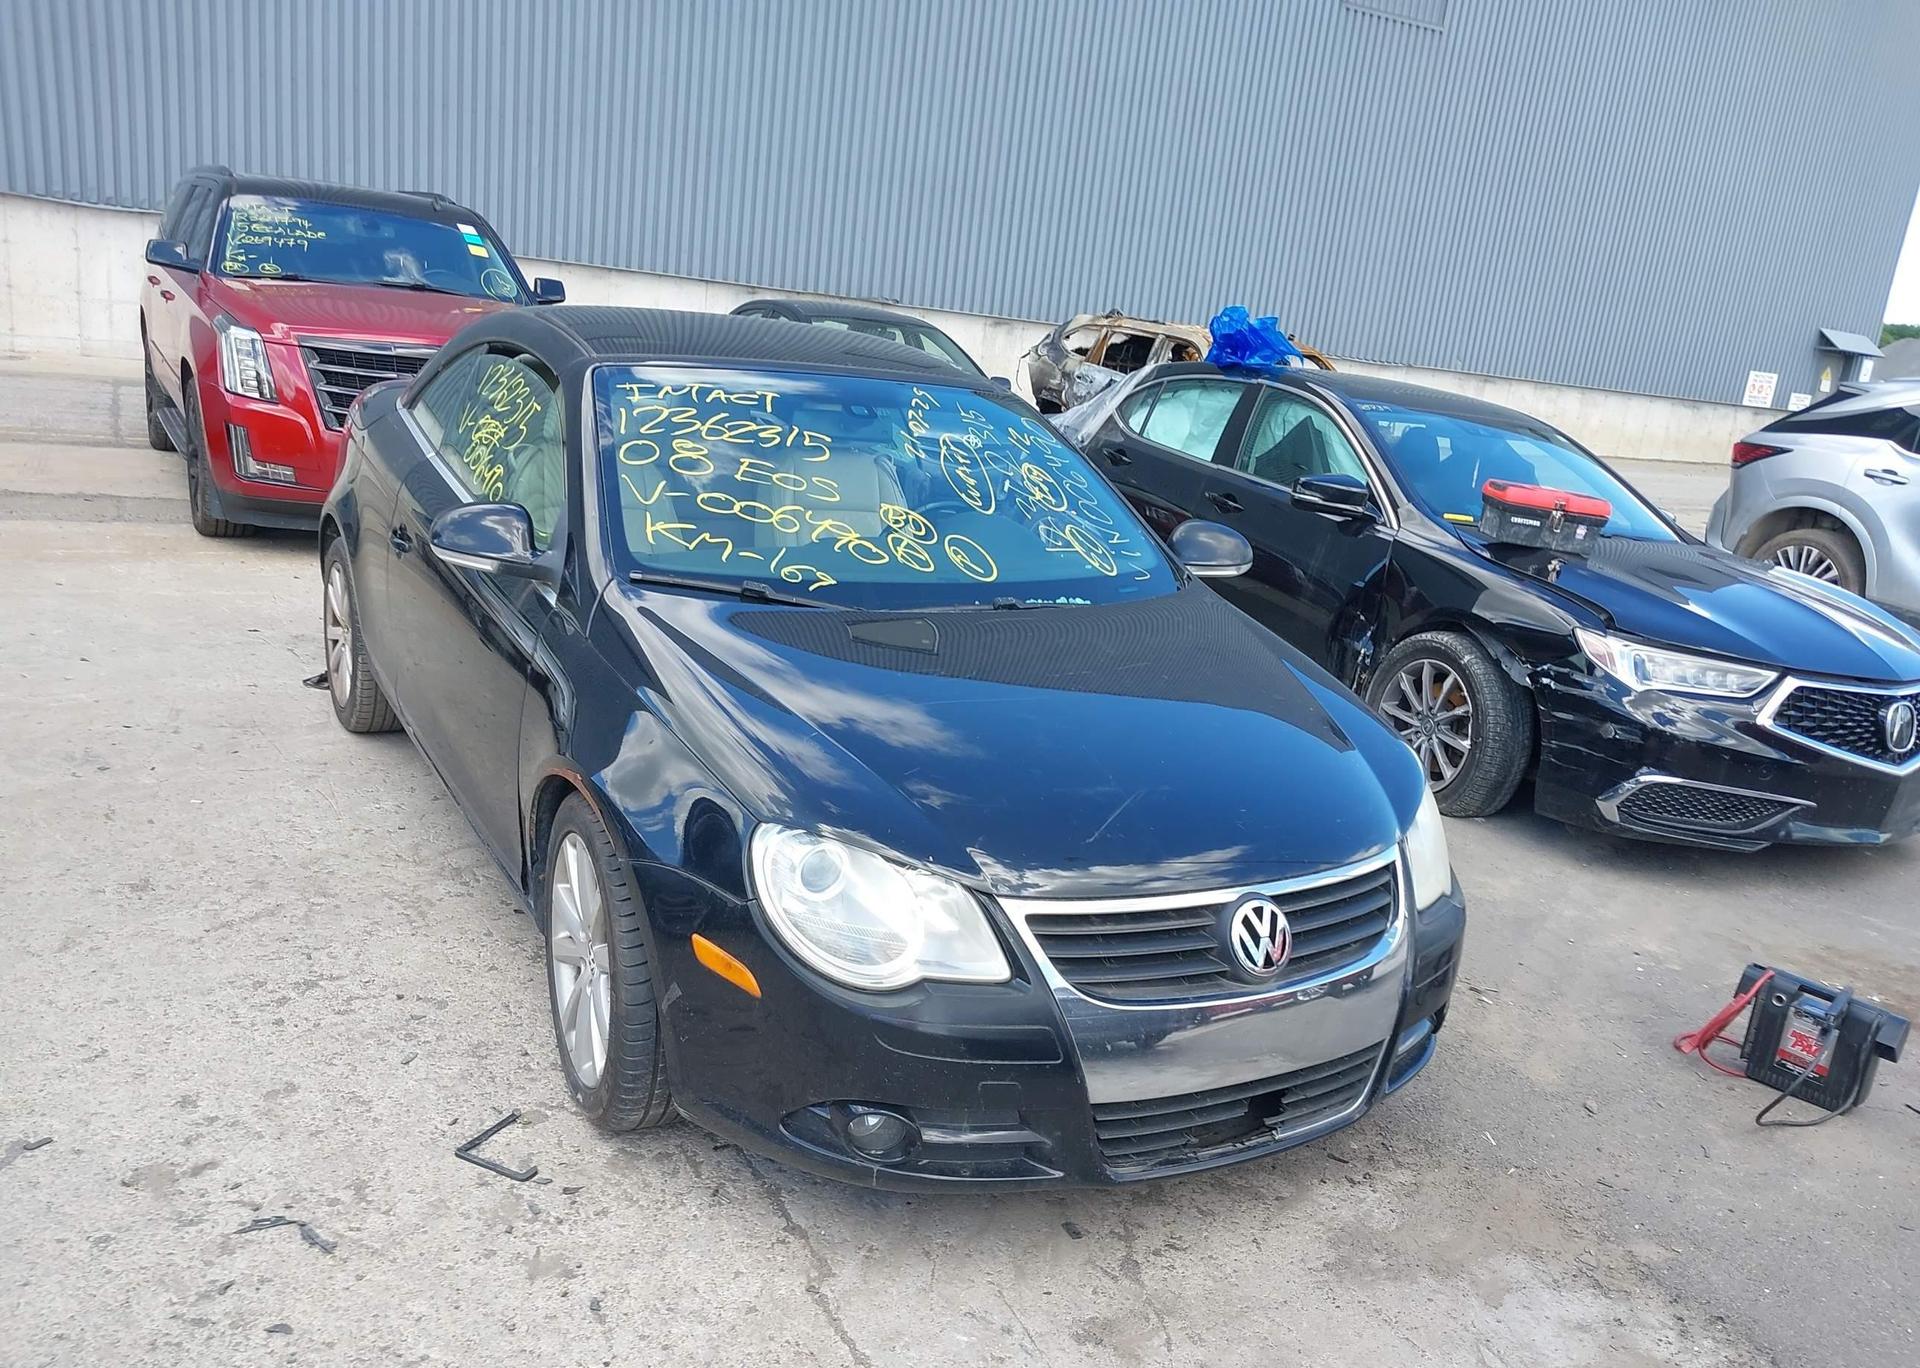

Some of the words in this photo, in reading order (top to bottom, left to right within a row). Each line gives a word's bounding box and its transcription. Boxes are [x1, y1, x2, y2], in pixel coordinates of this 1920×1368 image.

[616, 382, 780, 413] INTACT
[619, 405, 832, 461] 12362315
[618, 438, 714, 476] 08
[734, 458, 841, 501] EOS
[1231, 900, 1289, 976] VW
